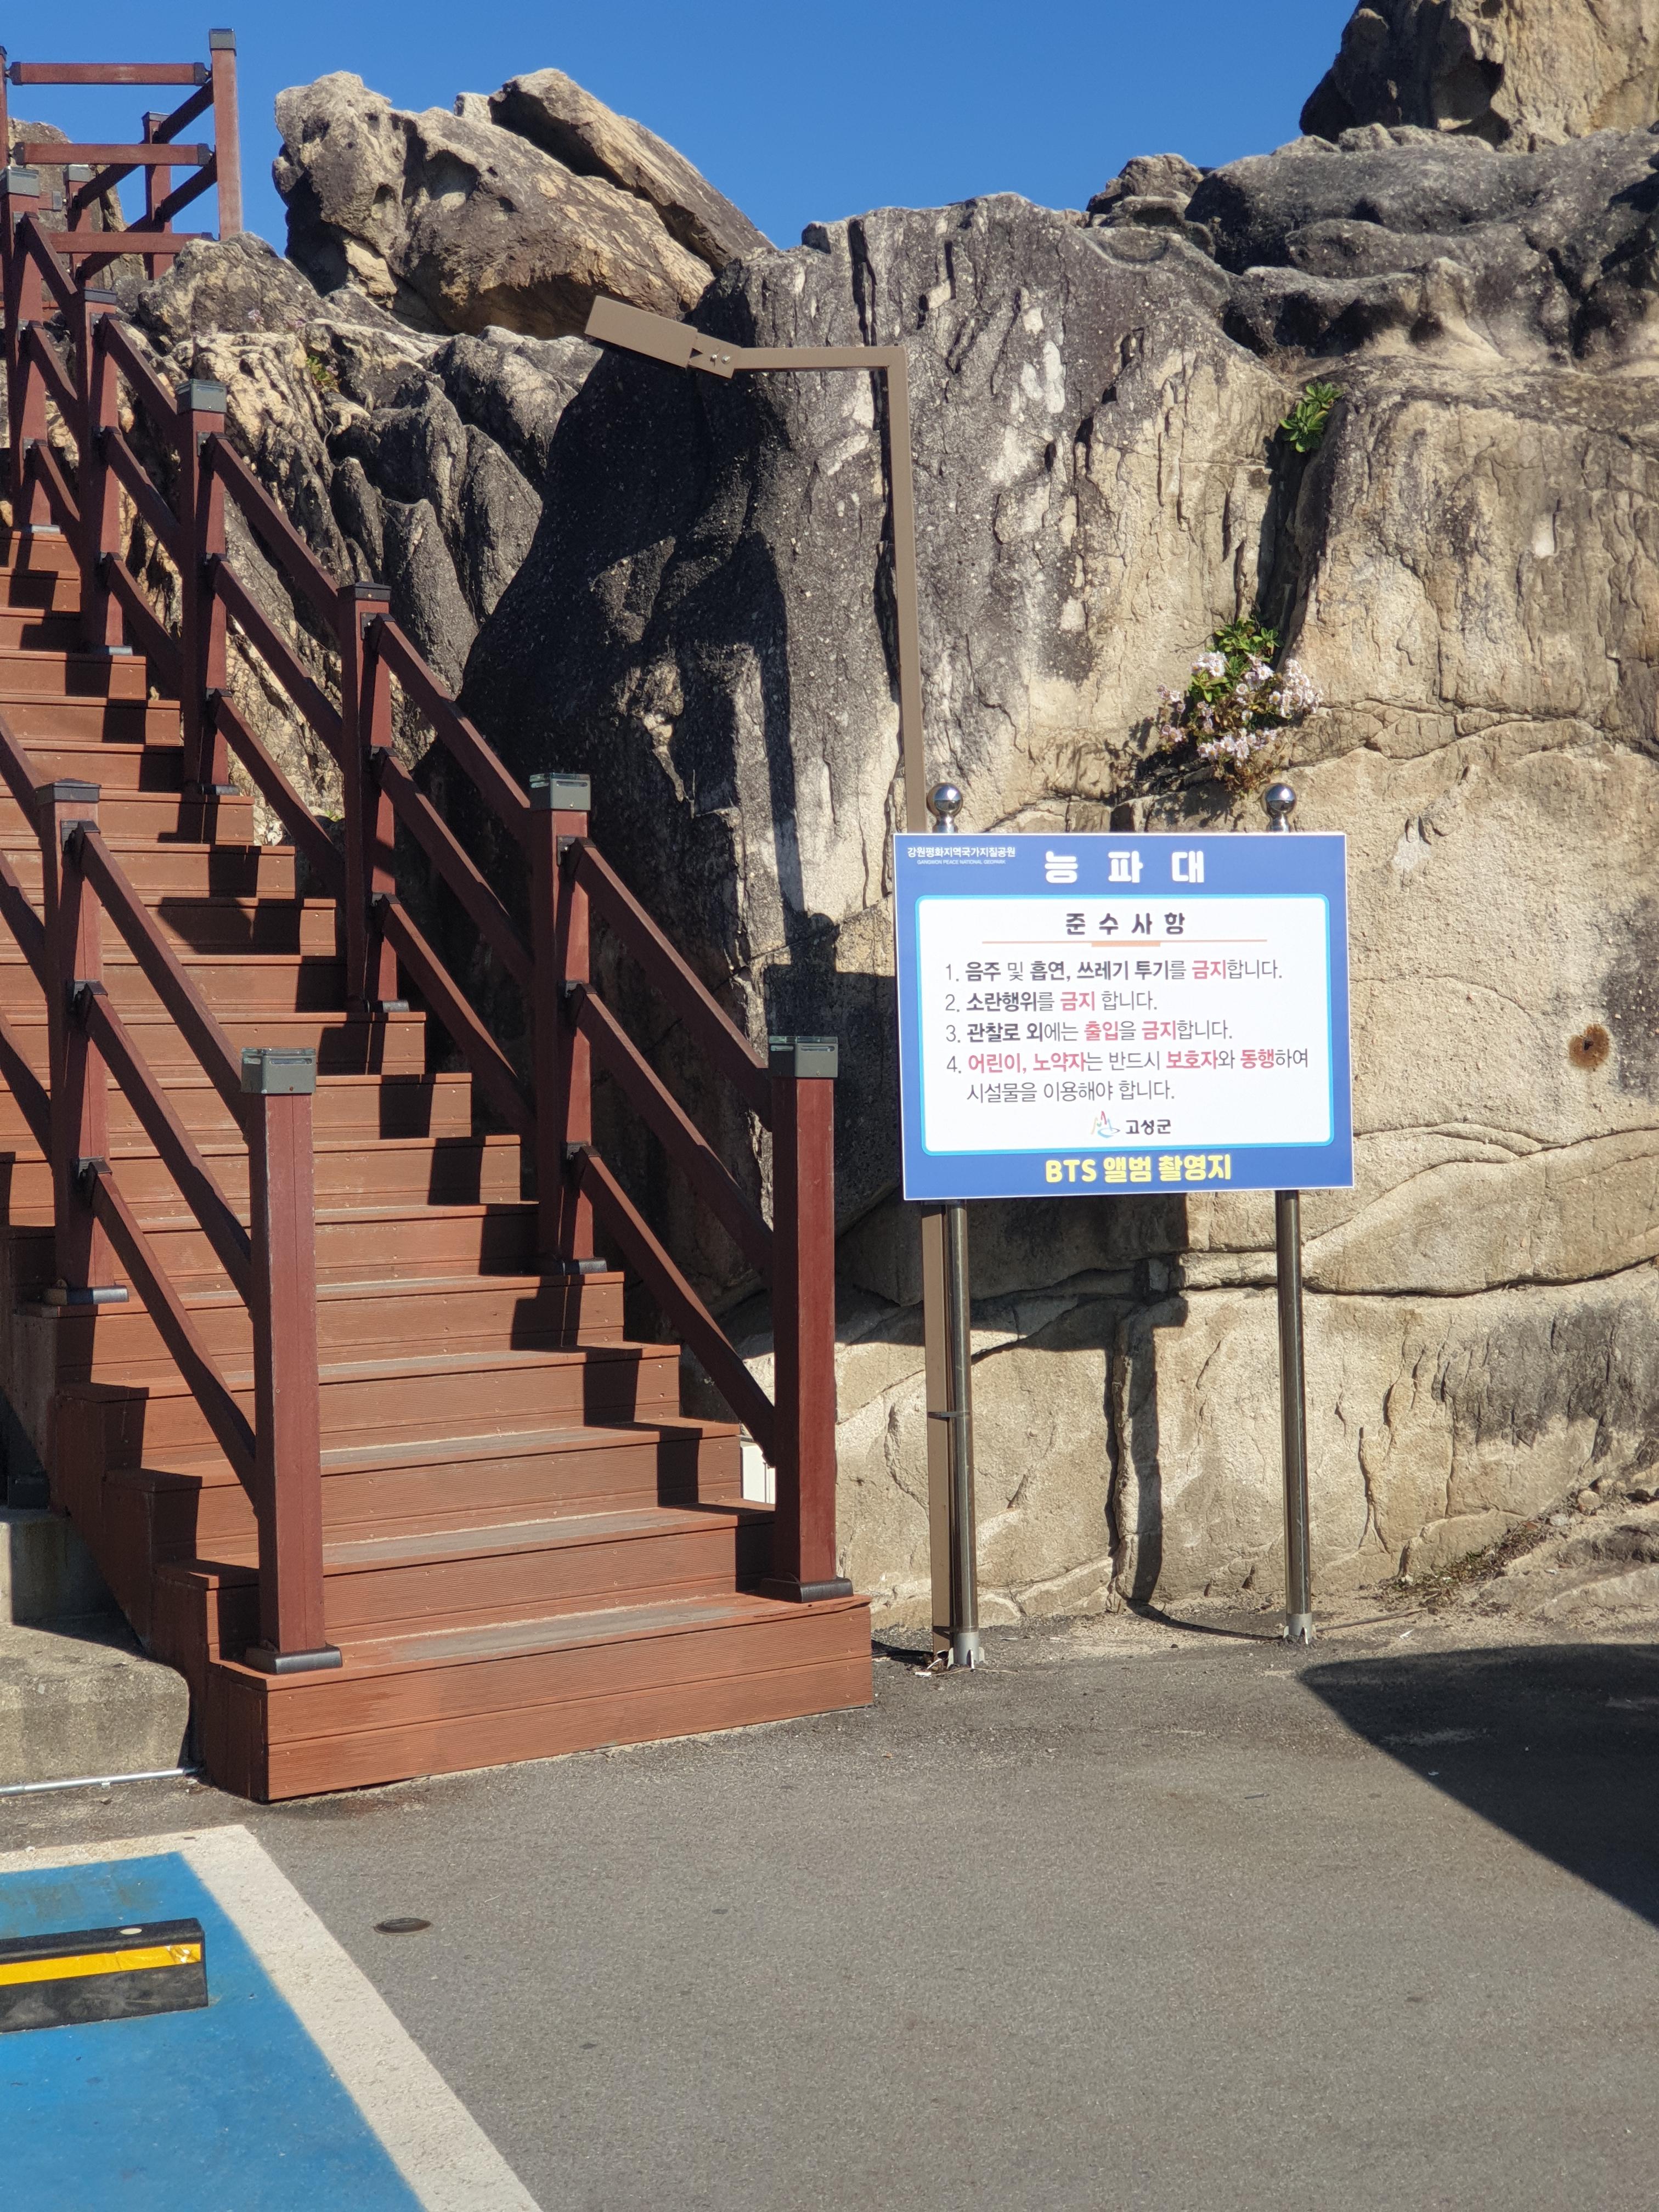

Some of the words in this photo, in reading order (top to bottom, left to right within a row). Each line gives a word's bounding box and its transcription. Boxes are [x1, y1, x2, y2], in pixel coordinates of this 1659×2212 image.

[907, 847, 1015, 857] 강원평화지역국가지질공원
[945, 963, 960, 982] 1.
[965, 961, 1001, 982] 음주
[1007, 961, 1023, 981] 및
[1030, 961, 1071, 982] 흡연,
[1076, 960, 1128, 981] 쓰레기
[1134, 960, 1187, 980] 투기를
[1192, 959, 1282, 980] 금지합니다.
[945, 994, 960, 1013] 2.
[966, 991, 1055, 1012] 소란행위를
[1060, 991, 1095, 1011] 금지
[1101, 990, 1157, 1011] 합니다.
[945, 1024, 961, 1043] 3.
[967, 1022, 1021, 1043] 관찰로
[1026, 1022, 1079, 1042] 외에는
[1084, 1020, 1137, 1041] 출입을
[1141, 1019, 1232, 1041] 금지합니다.
[946, 1056, 962, 1074] 4.
[968, 1053, 1027, 1074] 어린이,
[1032, 1052, 1103, 1073] 노약자는
[1109, 1051, 1160, 1071] 반드시
[1166, 1049, 1235, 1070] 보호자와
[1240, 1048, 1308, 1069] 동행하여
[967, 1082, 1037, 1104] 시설물을
[1043, 1081, 1114, 1102] 이용해야
[1118, 1080, 1175, 1101] 합니다.
[1125, 1118, 1172, 1136] 고성군
[1045, 1158, 1097, 1183] BTS
[1103, 1155, 1152, 1183] 앨범
[1158, 1153, 1232, 1182] 촬영지
